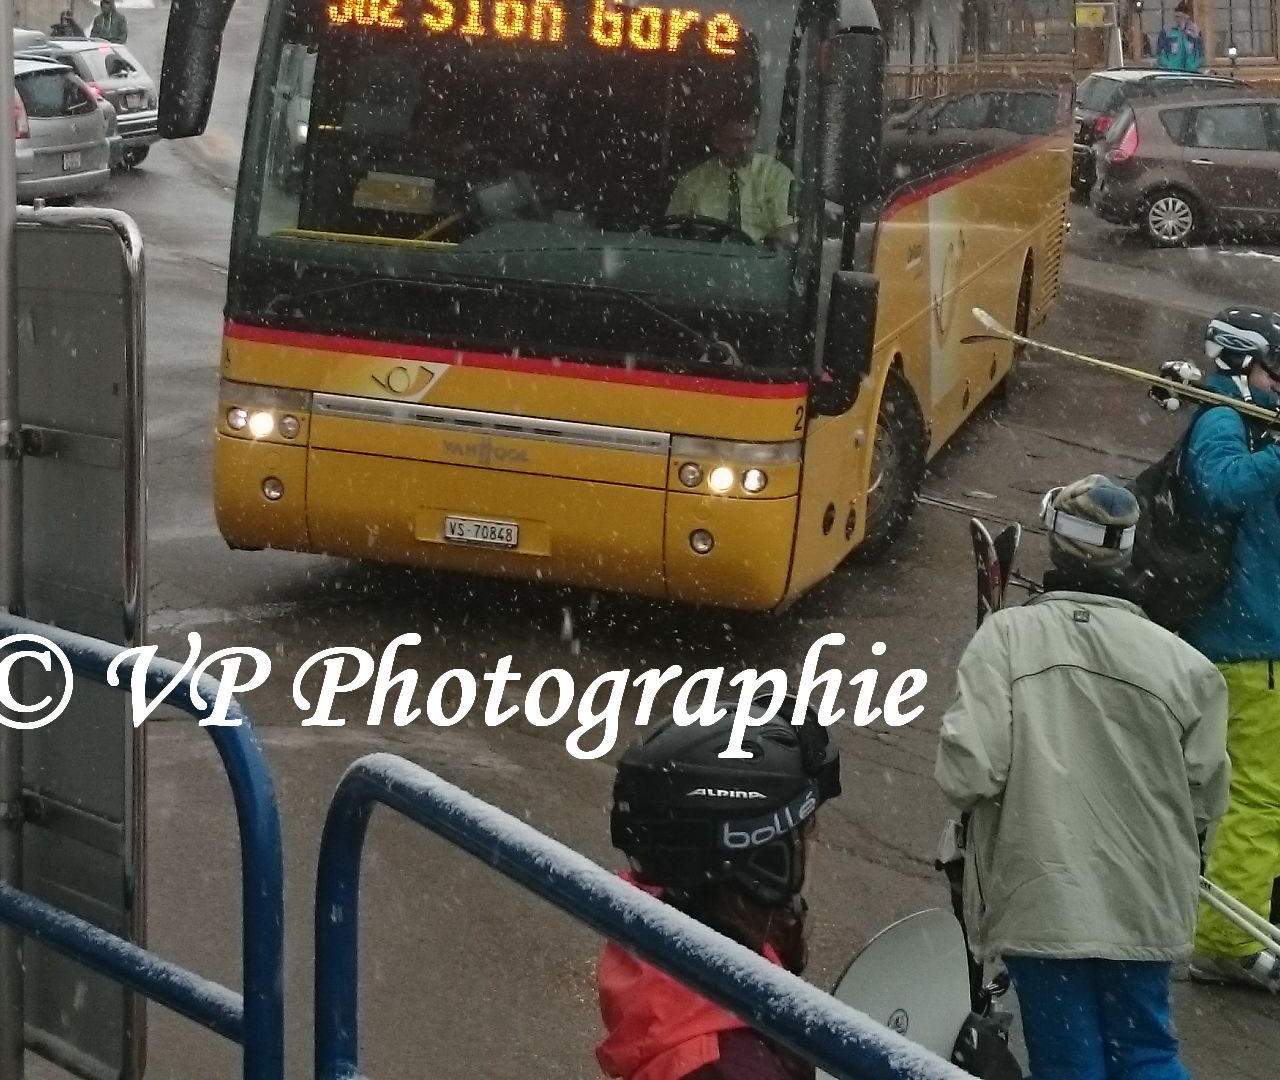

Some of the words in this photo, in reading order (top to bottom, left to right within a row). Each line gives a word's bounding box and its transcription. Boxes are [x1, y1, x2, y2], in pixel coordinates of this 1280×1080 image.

[794, 405, 804, 432] 2
[686, 788, 768, 799] ALPINA
[723, 790, 817, 849] bollé
